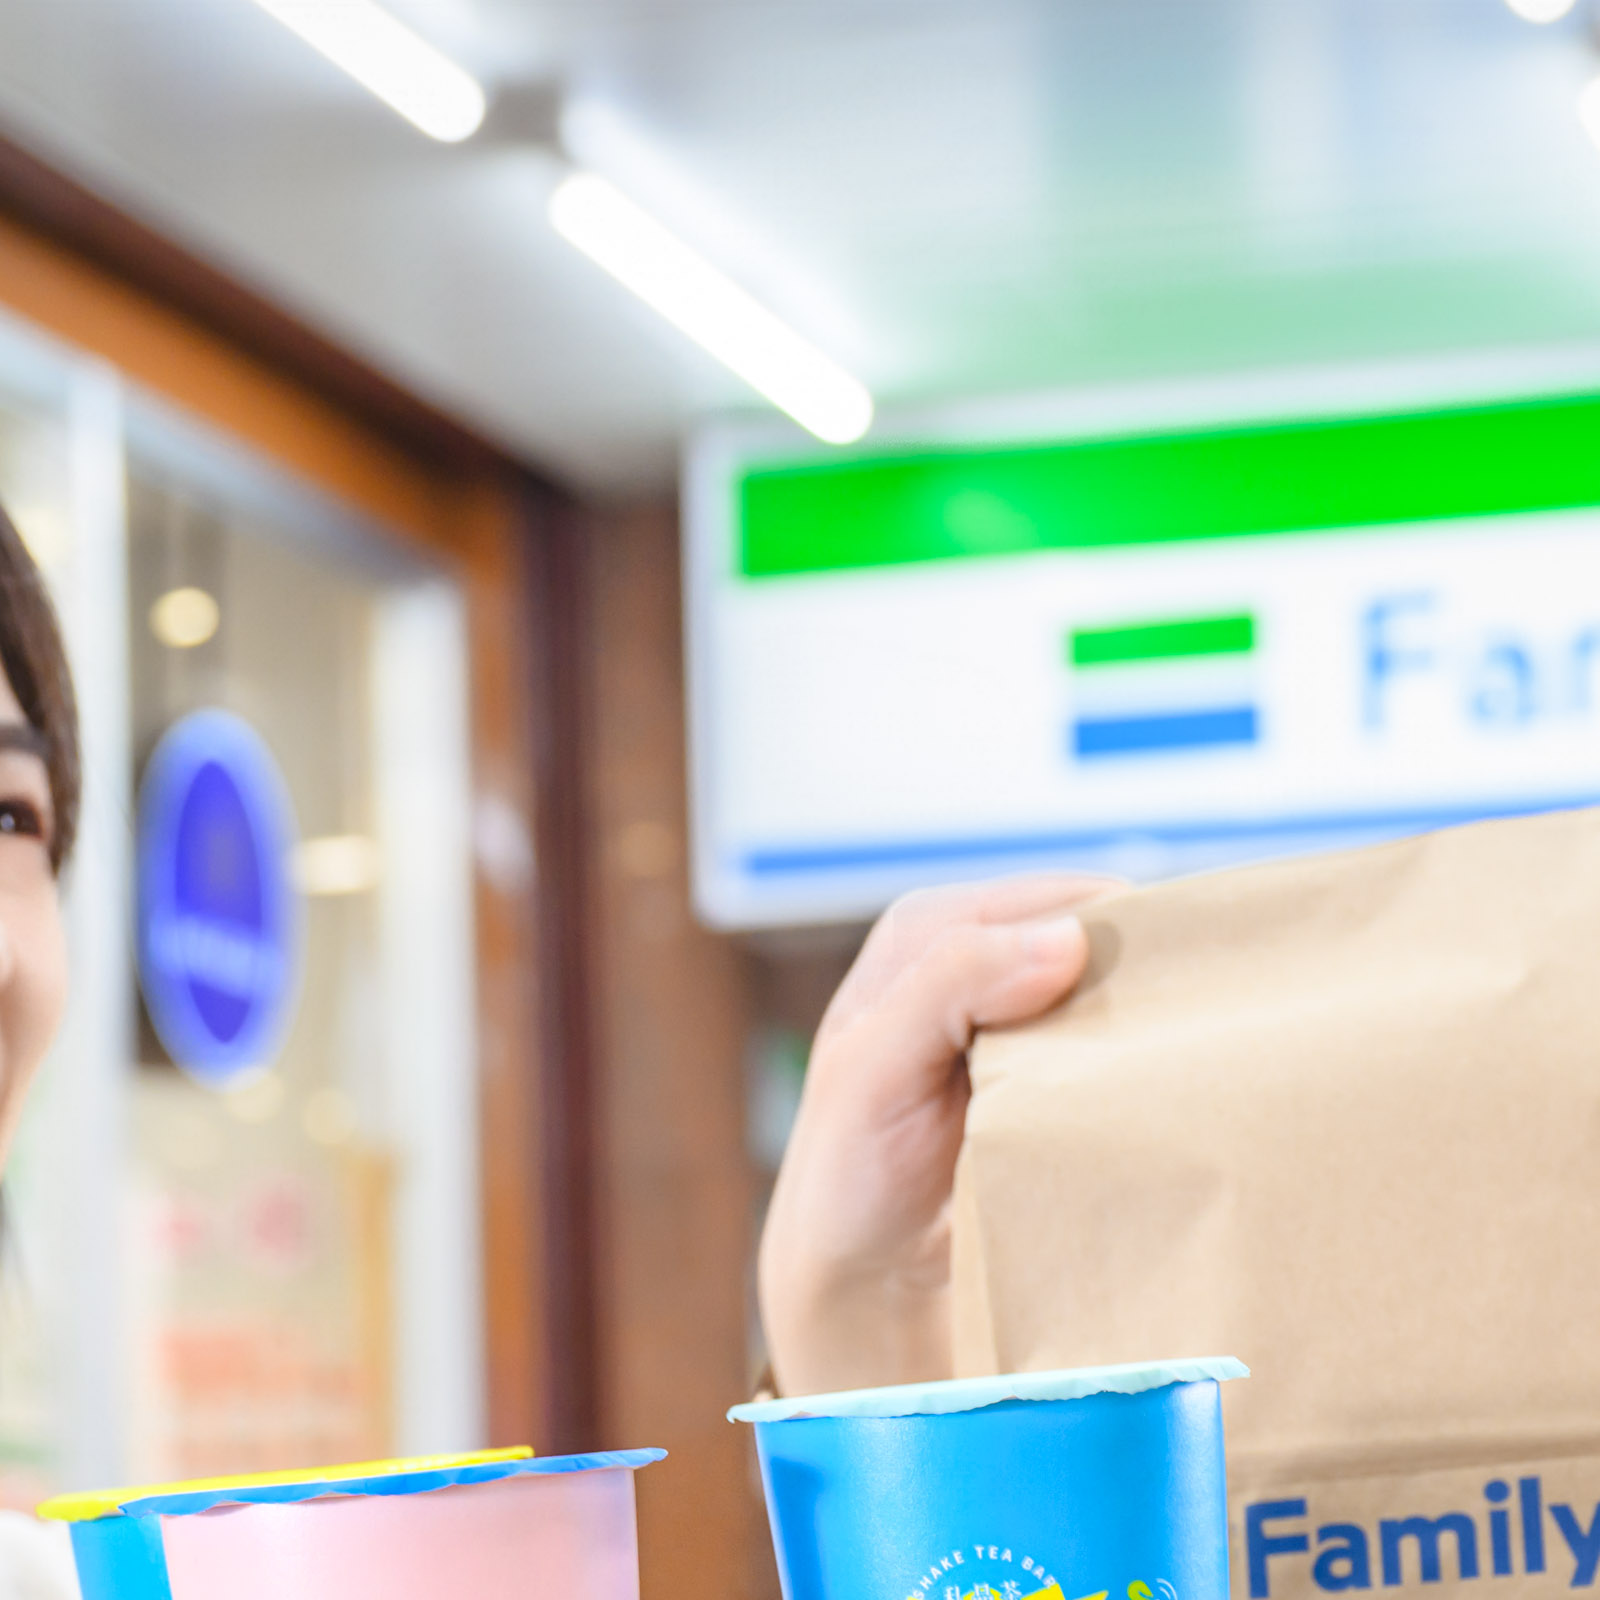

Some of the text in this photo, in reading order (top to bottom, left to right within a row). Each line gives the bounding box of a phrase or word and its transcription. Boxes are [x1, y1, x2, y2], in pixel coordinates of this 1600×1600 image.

[912, 1545, 1058, 1600] SHAKE TEA BAR
